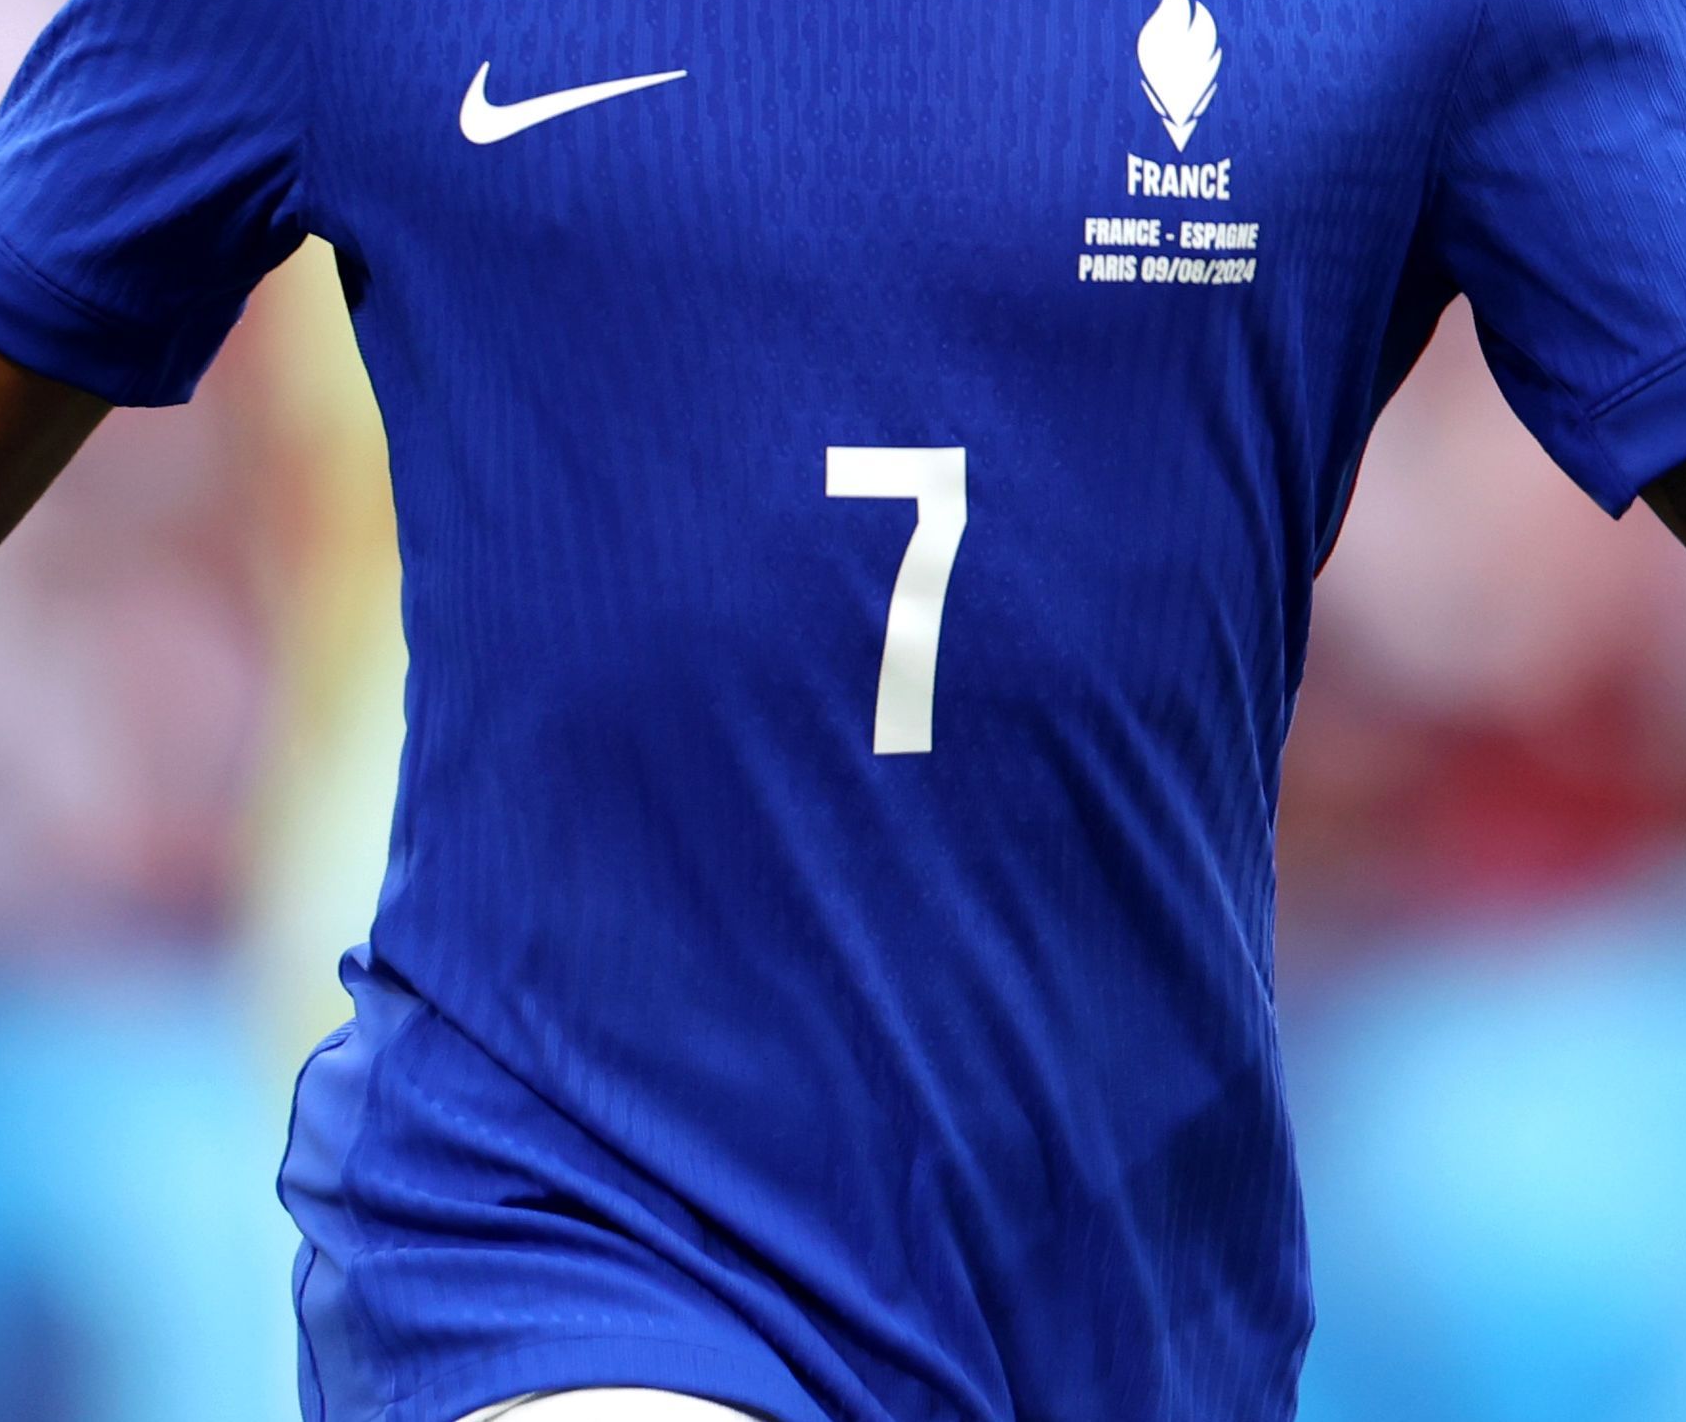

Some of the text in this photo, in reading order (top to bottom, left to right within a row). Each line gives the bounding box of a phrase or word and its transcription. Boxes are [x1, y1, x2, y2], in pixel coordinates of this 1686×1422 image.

[1126, 152, 1231, 201] FRANCE
[1084, 217, 1161, 247] FRANCE
[1179, 221, 1260, 250] ESPAGNE
[1078, 254, 1257, 285] PARIS 09/08/2024
[825, 445, 967, 755] 7
